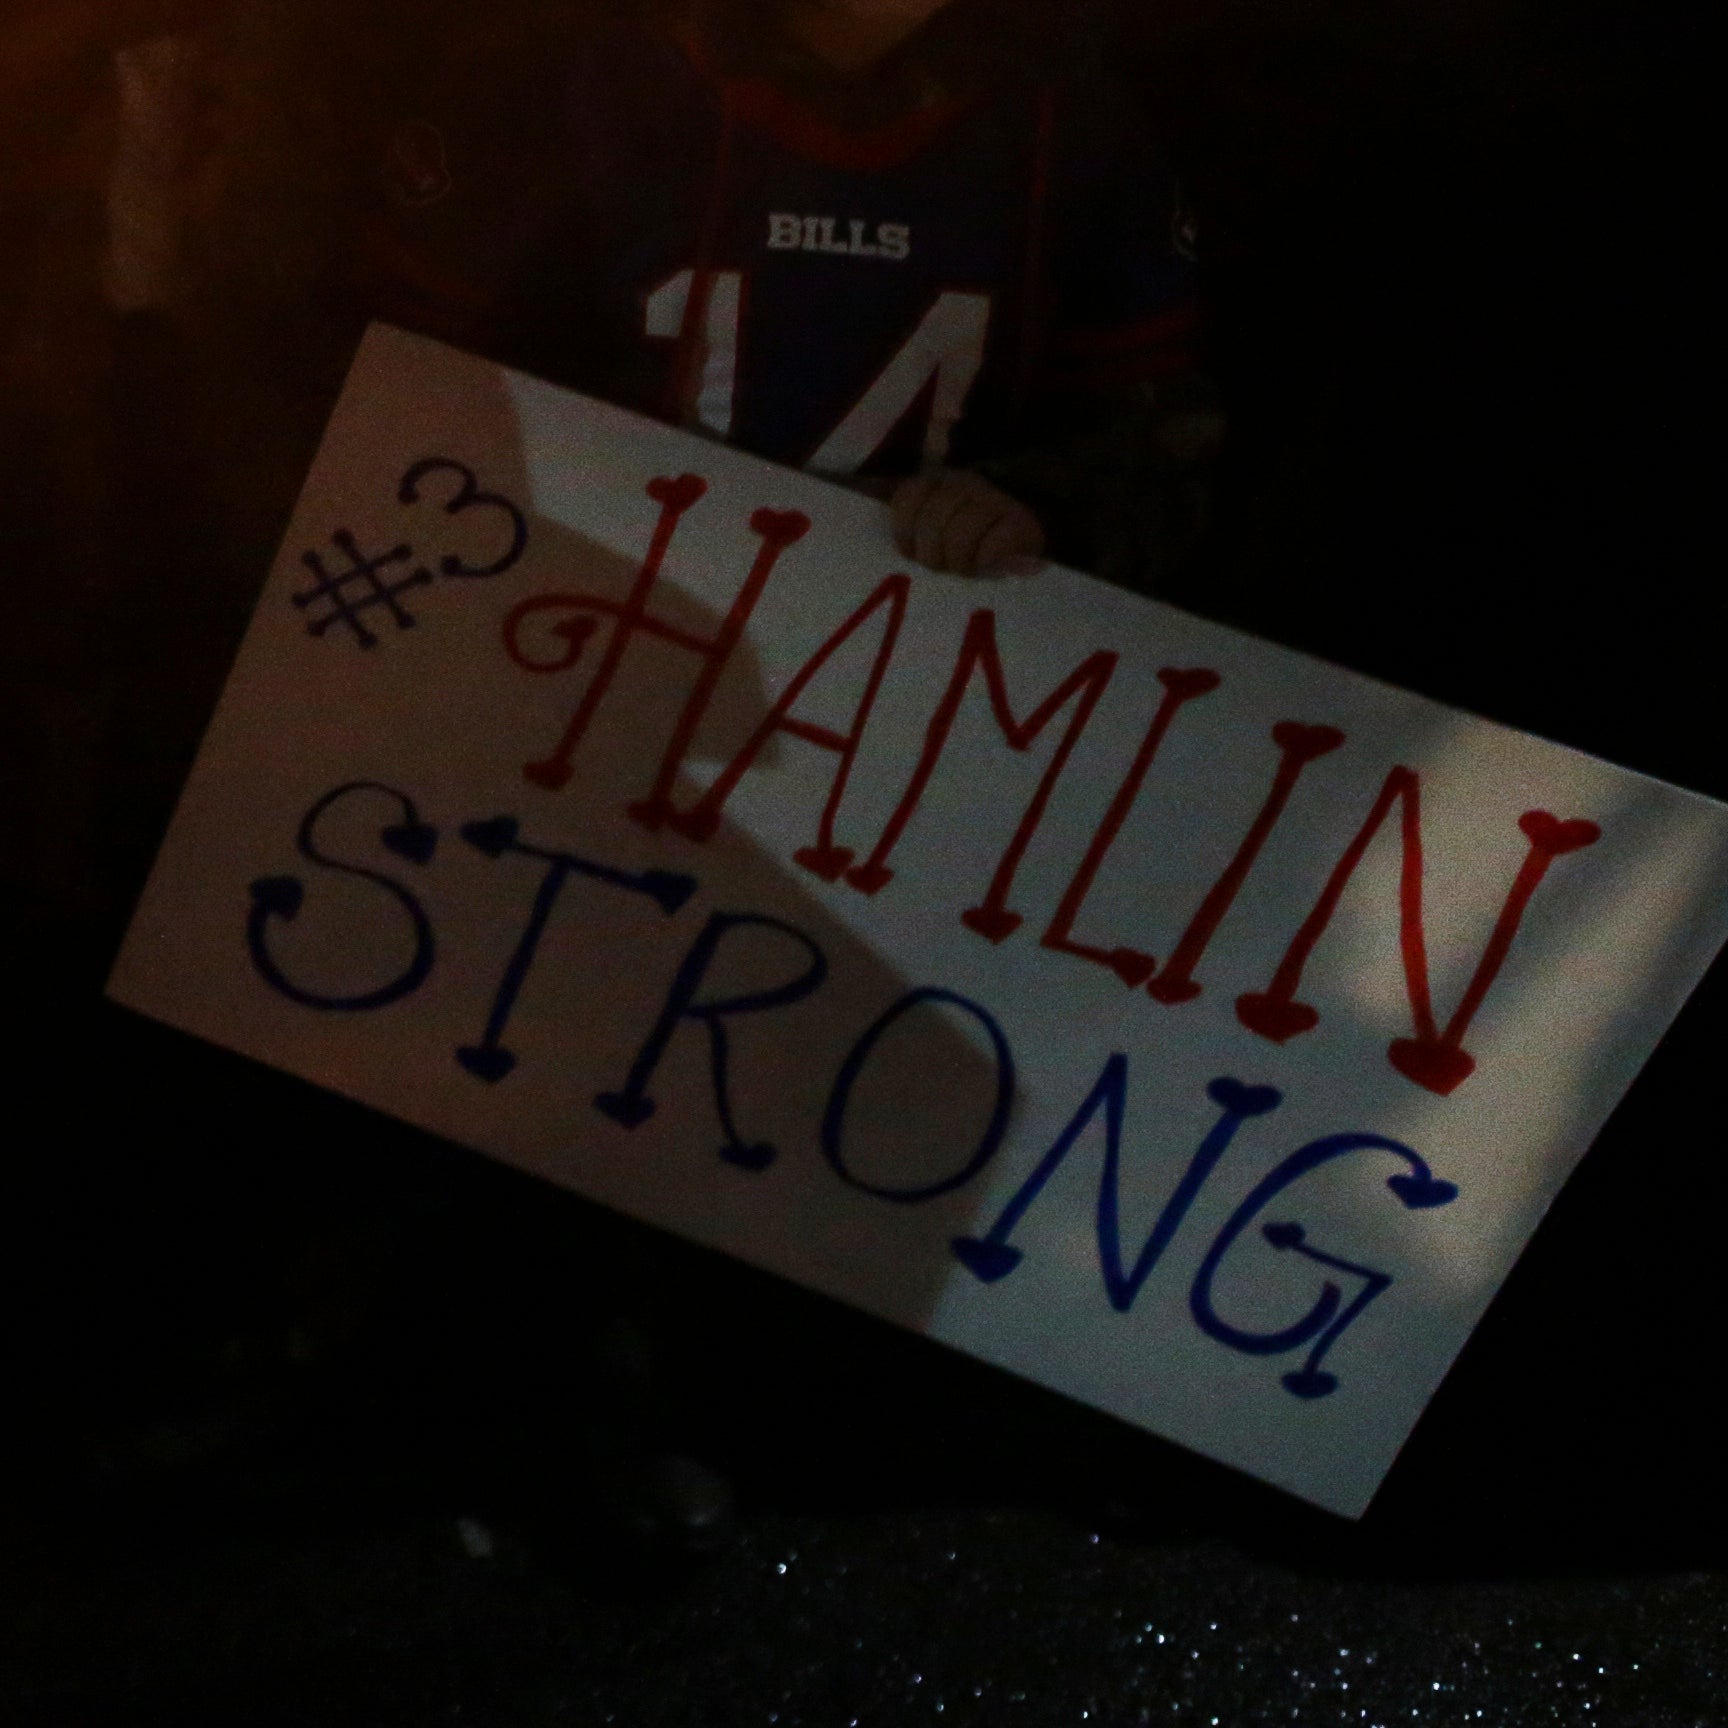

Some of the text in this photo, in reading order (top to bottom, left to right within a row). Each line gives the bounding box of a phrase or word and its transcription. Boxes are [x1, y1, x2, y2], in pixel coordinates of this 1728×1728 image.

[766, 212, 912, 261] BILLS
[644, 268, 992, 476] 14
[290, 455, 529, 652] #3
[501, 472, 1600, 1095] HAMLIN
[245, 780, 1459, 1400] STRONG
